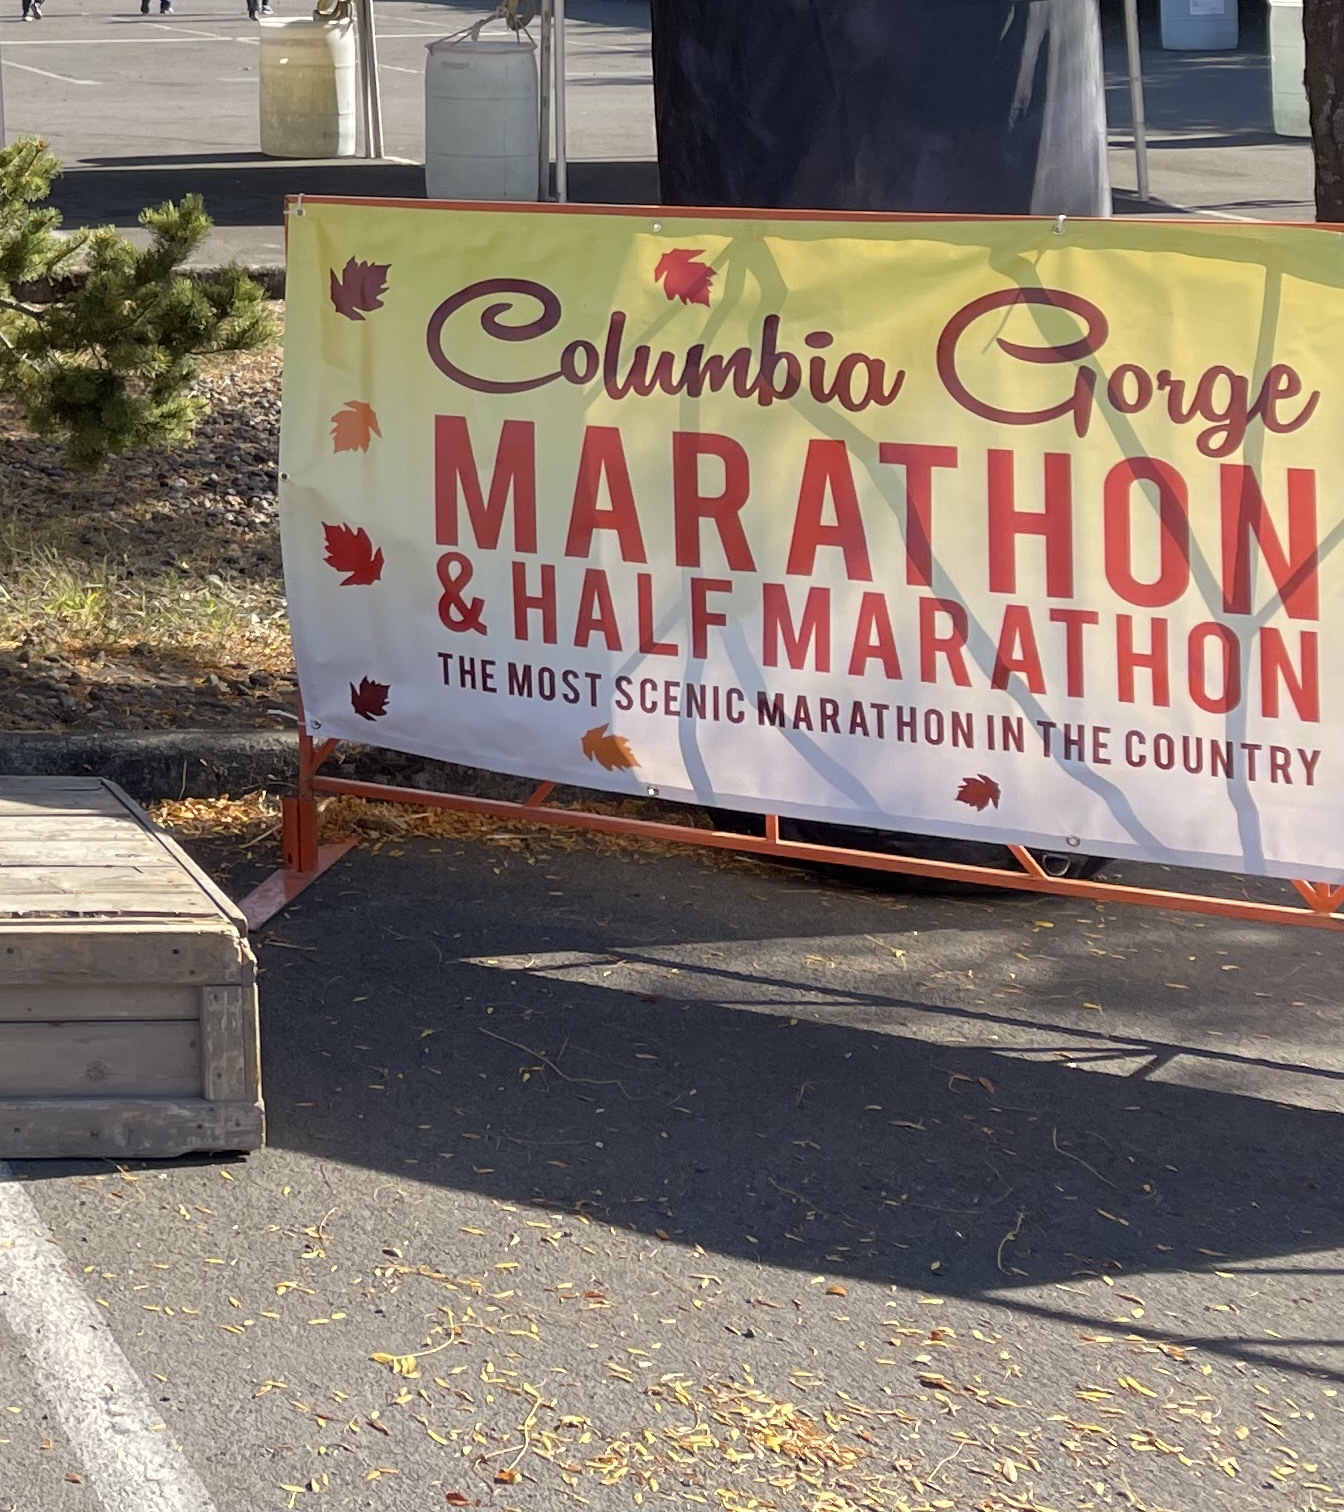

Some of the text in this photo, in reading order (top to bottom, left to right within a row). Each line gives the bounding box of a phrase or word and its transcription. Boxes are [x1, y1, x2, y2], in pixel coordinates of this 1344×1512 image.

[427, 277, 1321, 459] Columbia Gorge
[434, 413, 1320, 622] MARATHON
[436, 551, 1321, 724] & HALF MARATHON
[437, 652, 1321, 787] THE MOST SCENIC MARATHON IN THE COUNTRY
